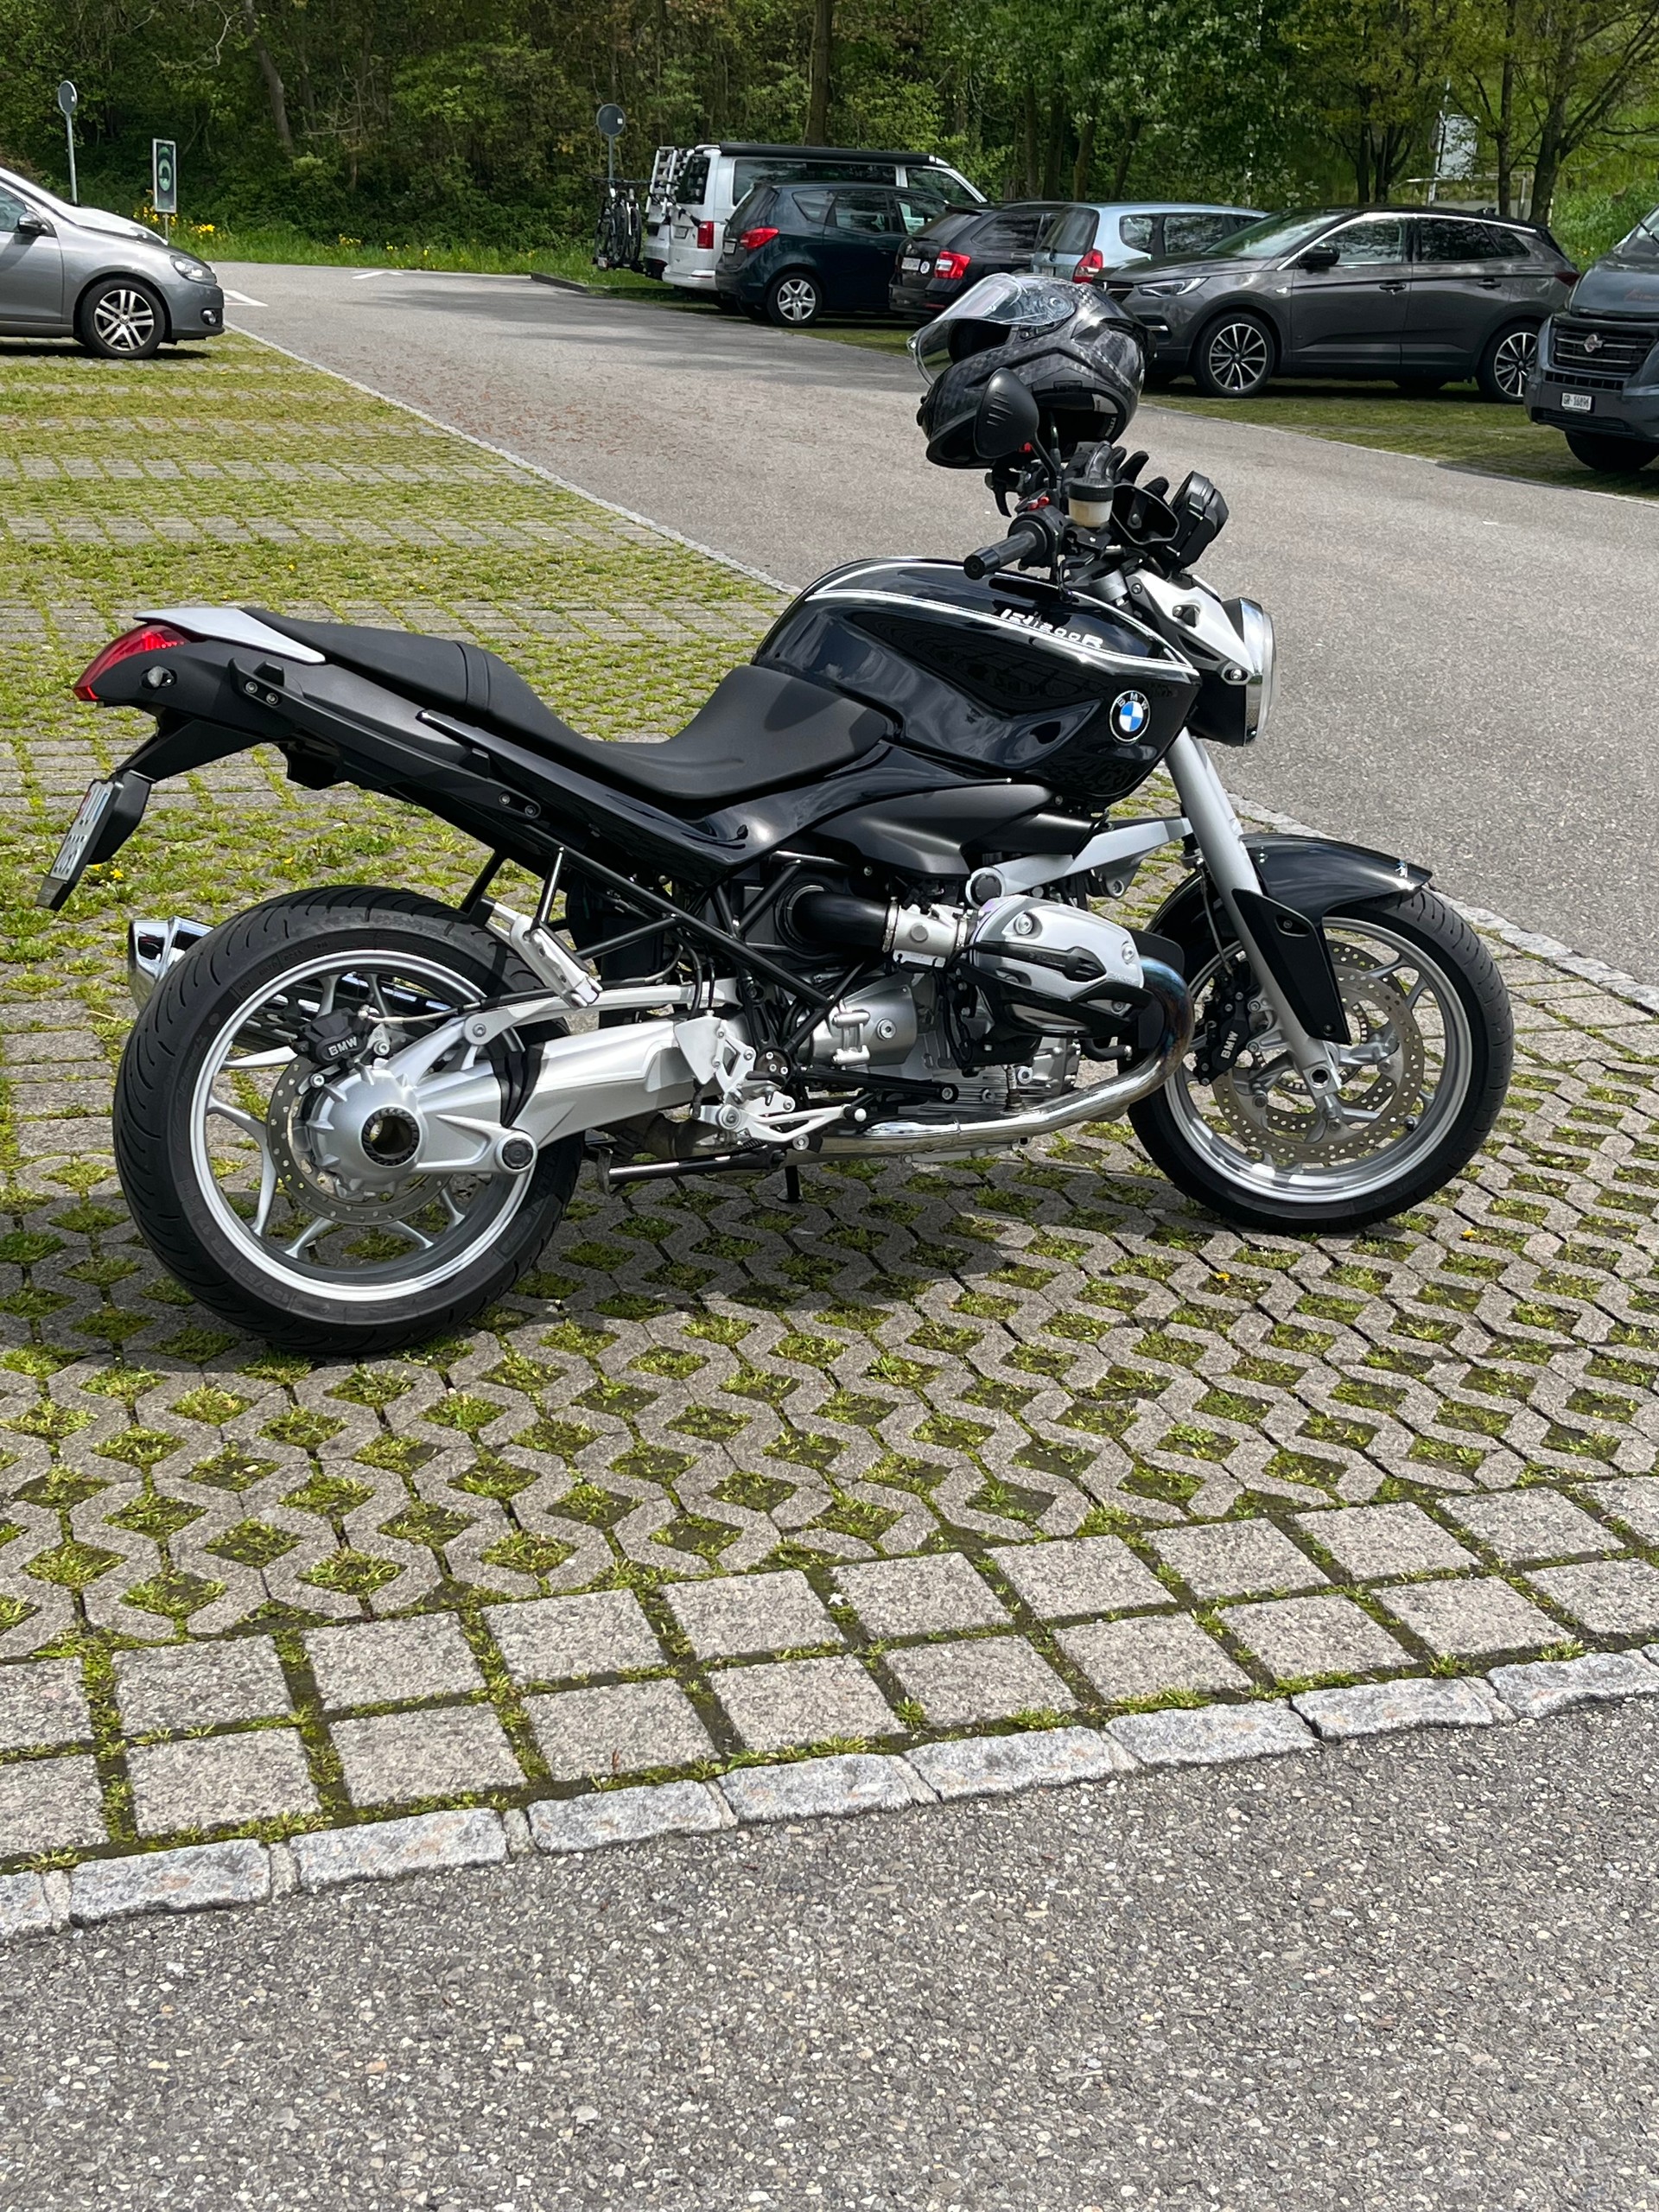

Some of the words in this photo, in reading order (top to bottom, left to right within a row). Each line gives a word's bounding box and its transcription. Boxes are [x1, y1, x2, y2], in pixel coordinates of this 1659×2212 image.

[1116, 692, 1148, 710] BMW
[327, 1036, 359, 1056] BMW
[1221, 1031, 1238, 1058] BMW
